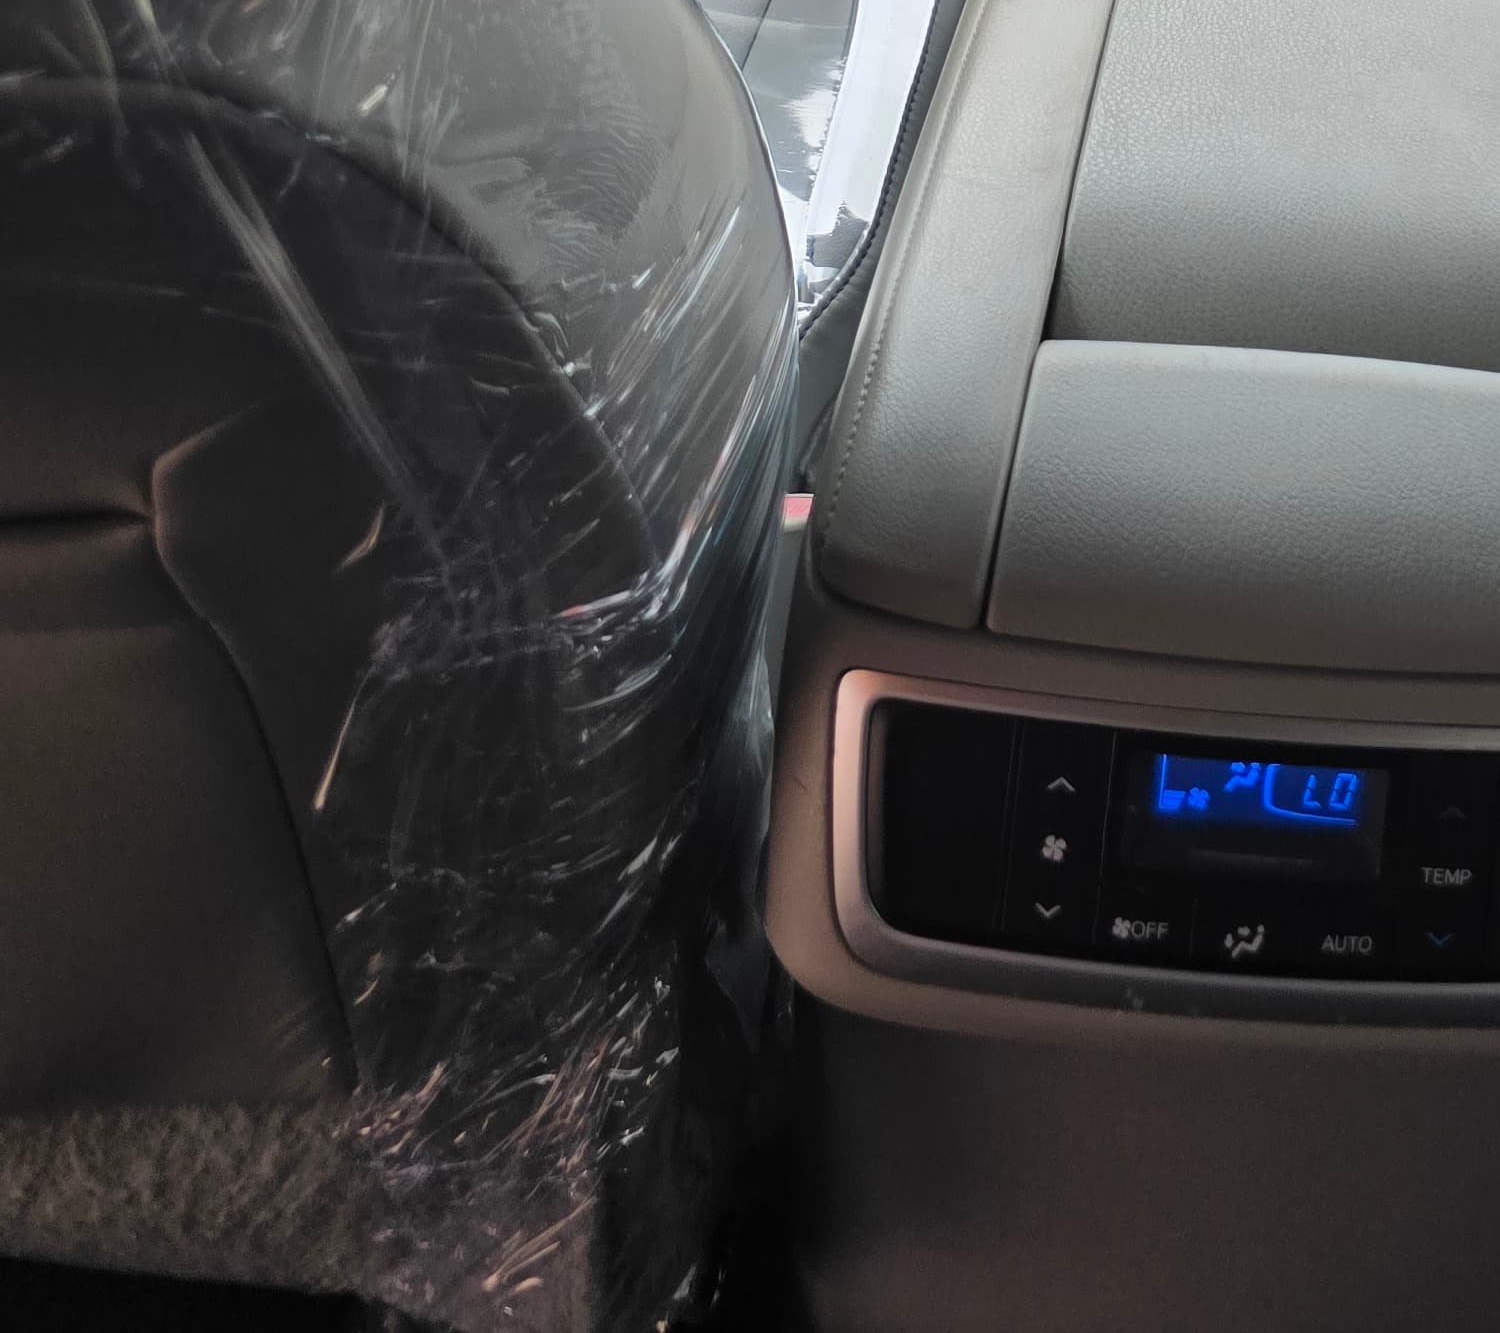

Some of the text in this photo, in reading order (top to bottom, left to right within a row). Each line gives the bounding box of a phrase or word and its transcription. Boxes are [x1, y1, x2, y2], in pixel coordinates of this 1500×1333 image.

[1303, 772, 1358, 810] LO
[1421, 866, 1473, 885] TEMP
[1131, 920, 1169, 941] OFF
[1321, 933, 1374, 954] AUTO
